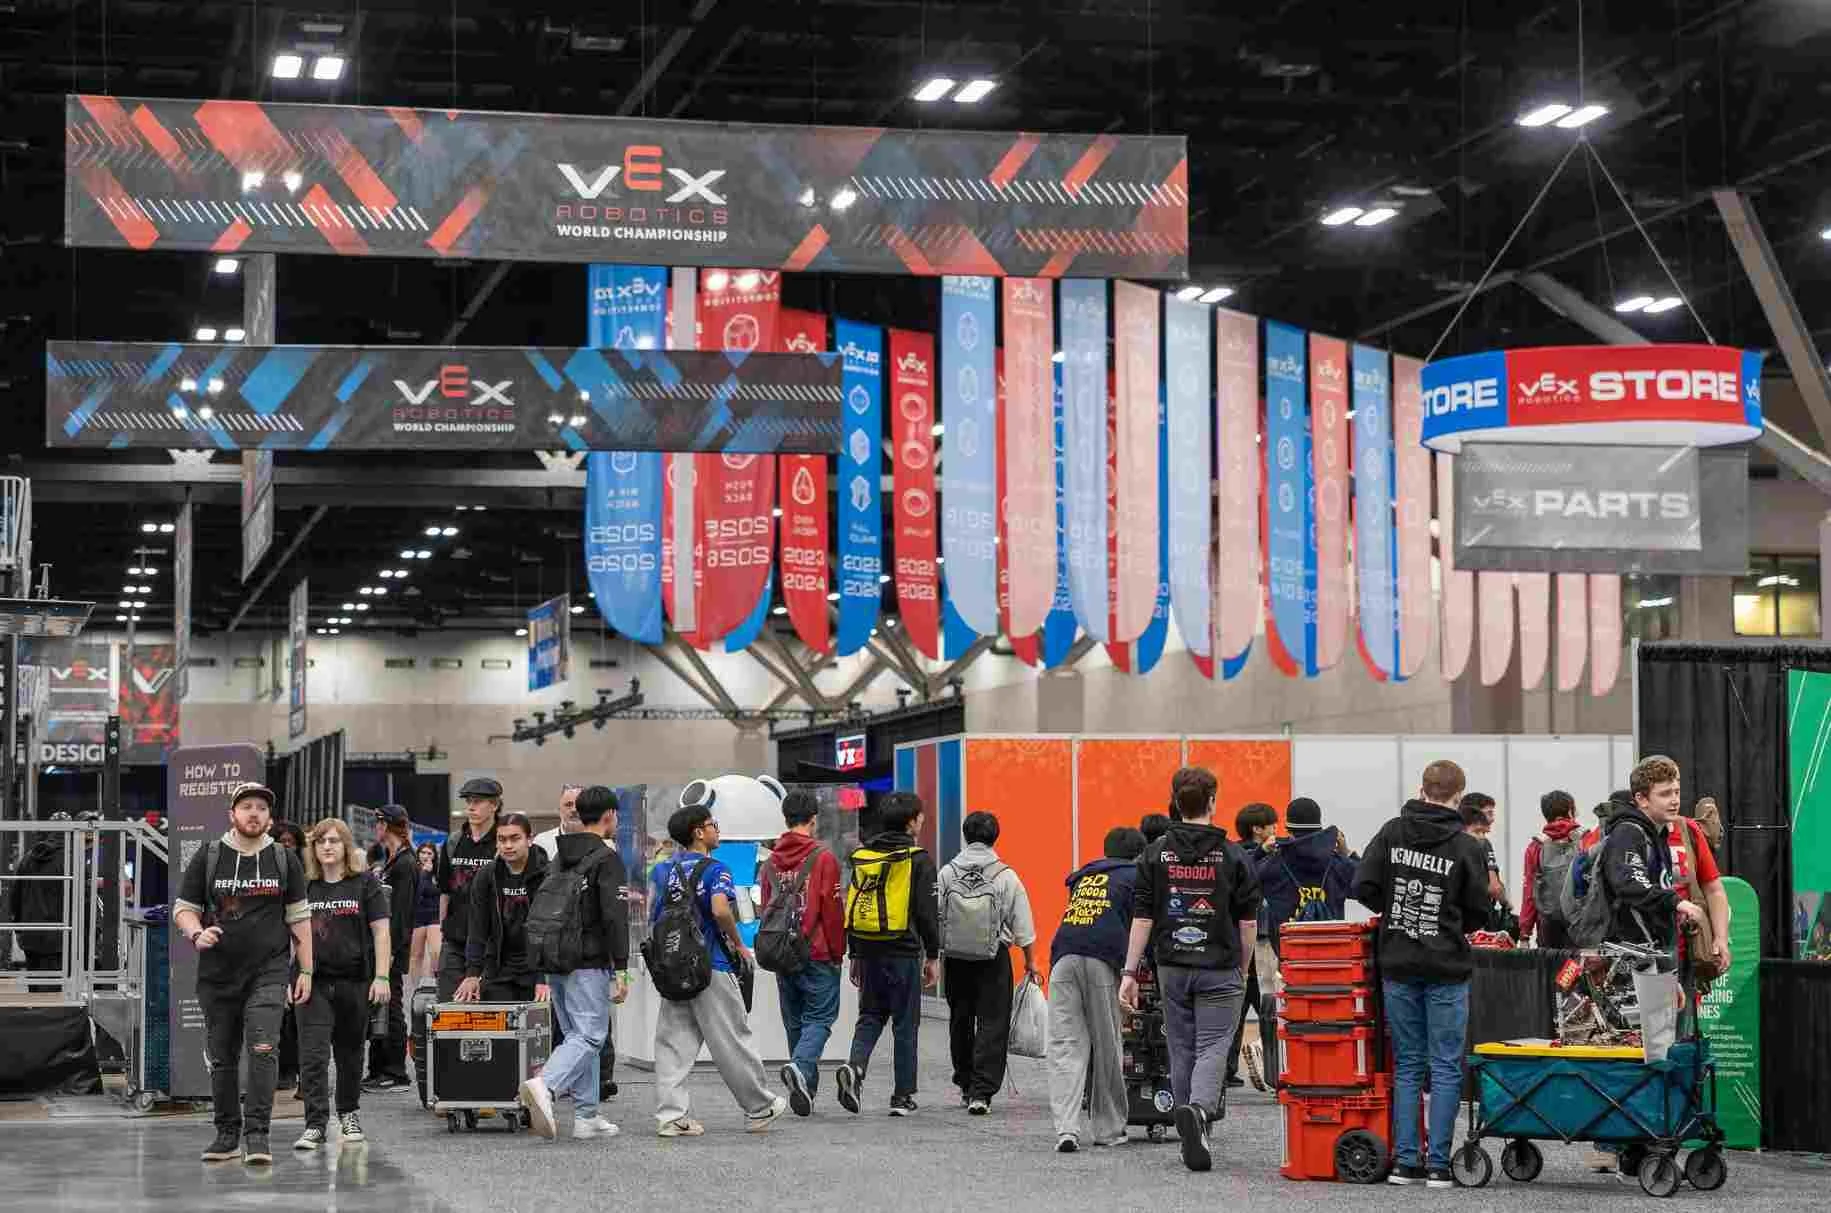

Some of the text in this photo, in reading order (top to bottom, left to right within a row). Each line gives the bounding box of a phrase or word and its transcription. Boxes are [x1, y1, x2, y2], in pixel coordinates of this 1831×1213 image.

[557, 145, 728, 205] VEX
[556, 205, 729, 225] ROBOTICS
[556, 225, 727, 242] WORLD CHAMPIONSHIP
[393, 365, 515, 406] VEX
[1518, 369, 1739, 403] VEX STORE
[393, 423, 515, 432] WORLD CHAMPIONSHIP
[1473, 489, 1690, 519] VEX PARTS
[783, 547, 824, 566] 2023
[783, 573, 824, 591] 2024
[41, 743, 105, 762] DESIG
[185, 763, 240, 779] HOW TO
[180, 780, 246, 797] REGISTE
[1391, 848, 1454, 876] KENNELLY
[215, 879, 279, 889] REFRACTION
[310, 900, 359, 911] EFRACTION
